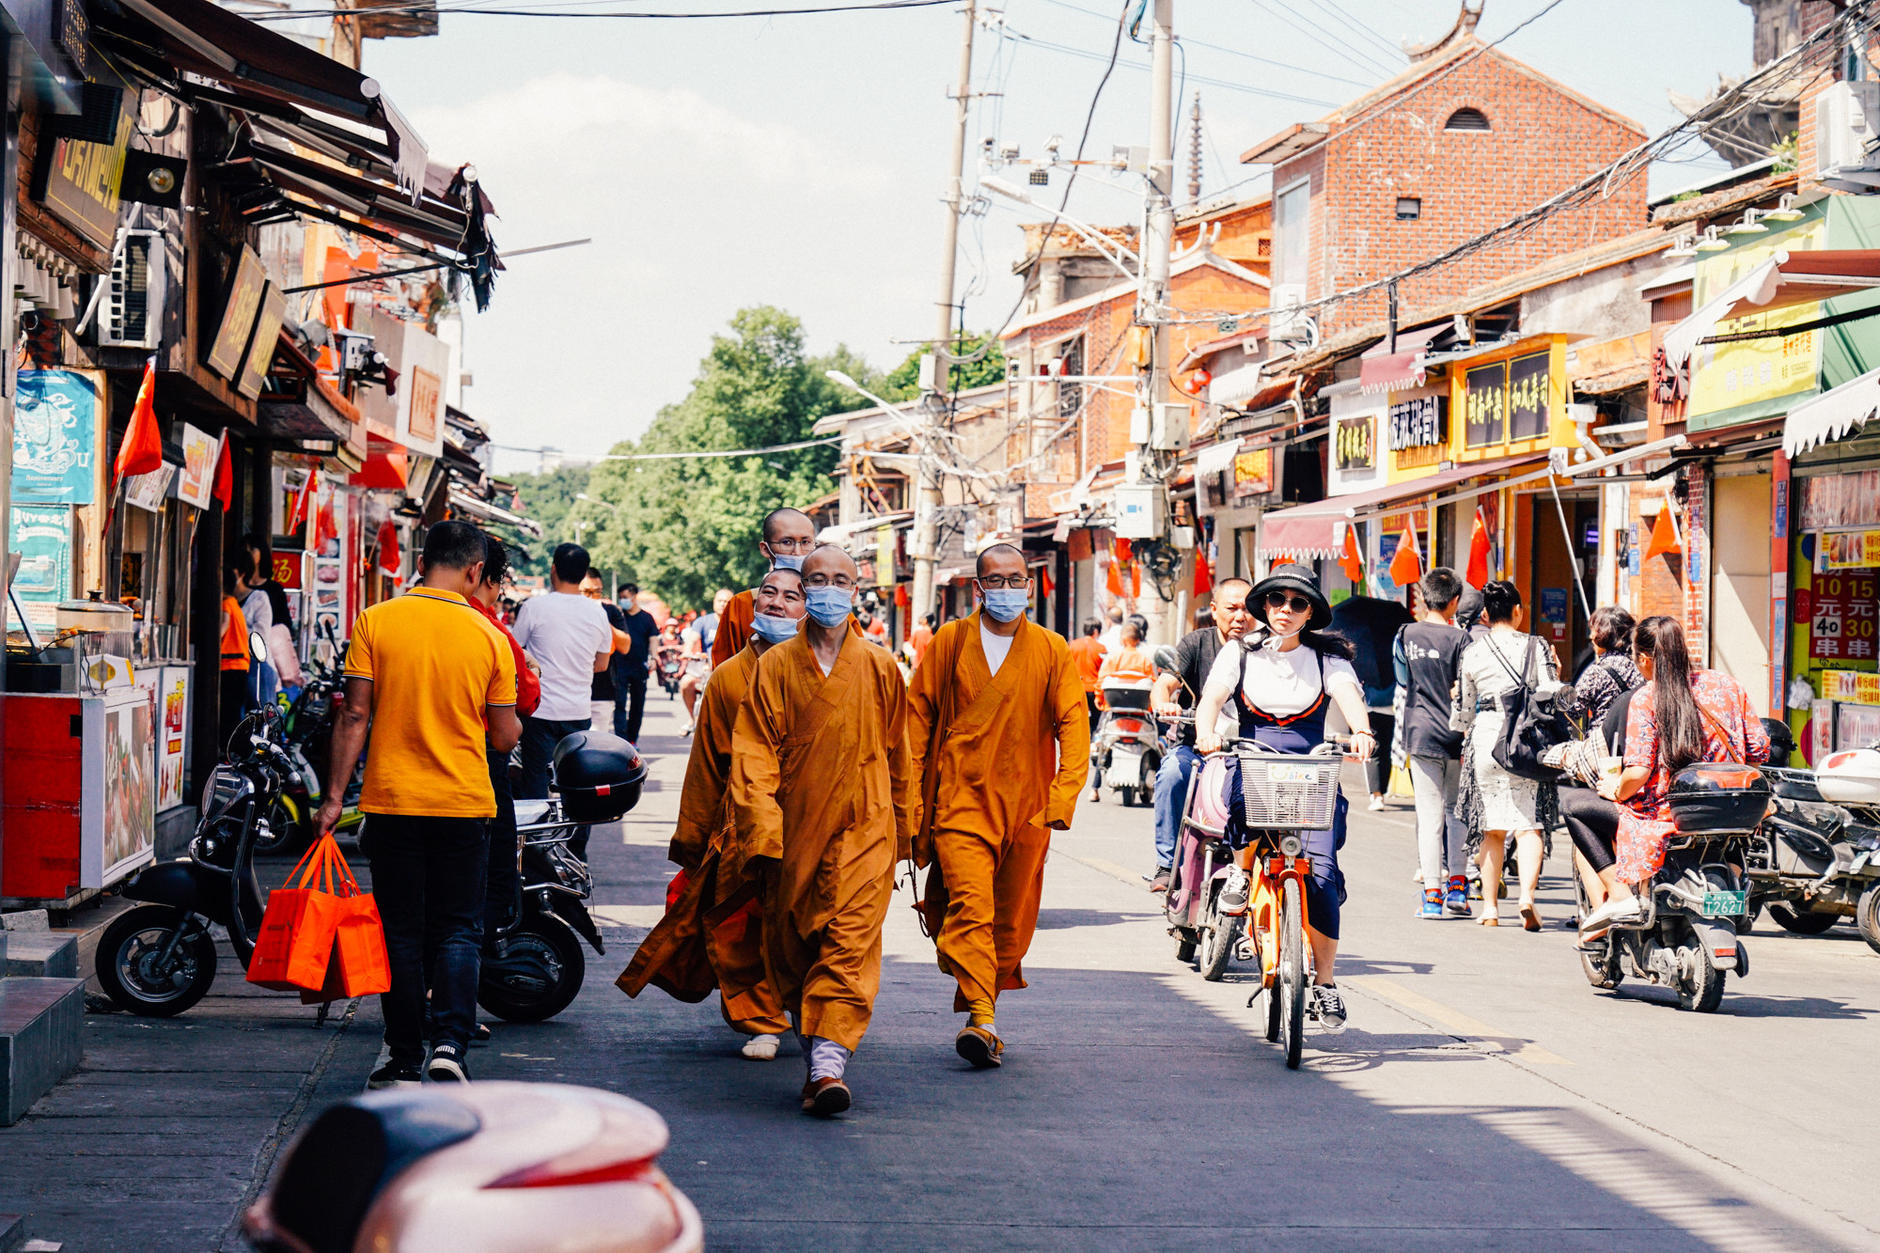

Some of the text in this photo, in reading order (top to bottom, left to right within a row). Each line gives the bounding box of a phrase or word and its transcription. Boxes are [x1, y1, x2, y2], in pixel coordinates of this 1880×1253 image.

[1816, 578, 1873, 598] 10 15
[1816, 599, 1873, 616] 元 元
[1816, 617, 1873, 637] 40 30
[1816, 638, 1871, 657] 串 串
[1705, 901, 1743, 914] T2627
